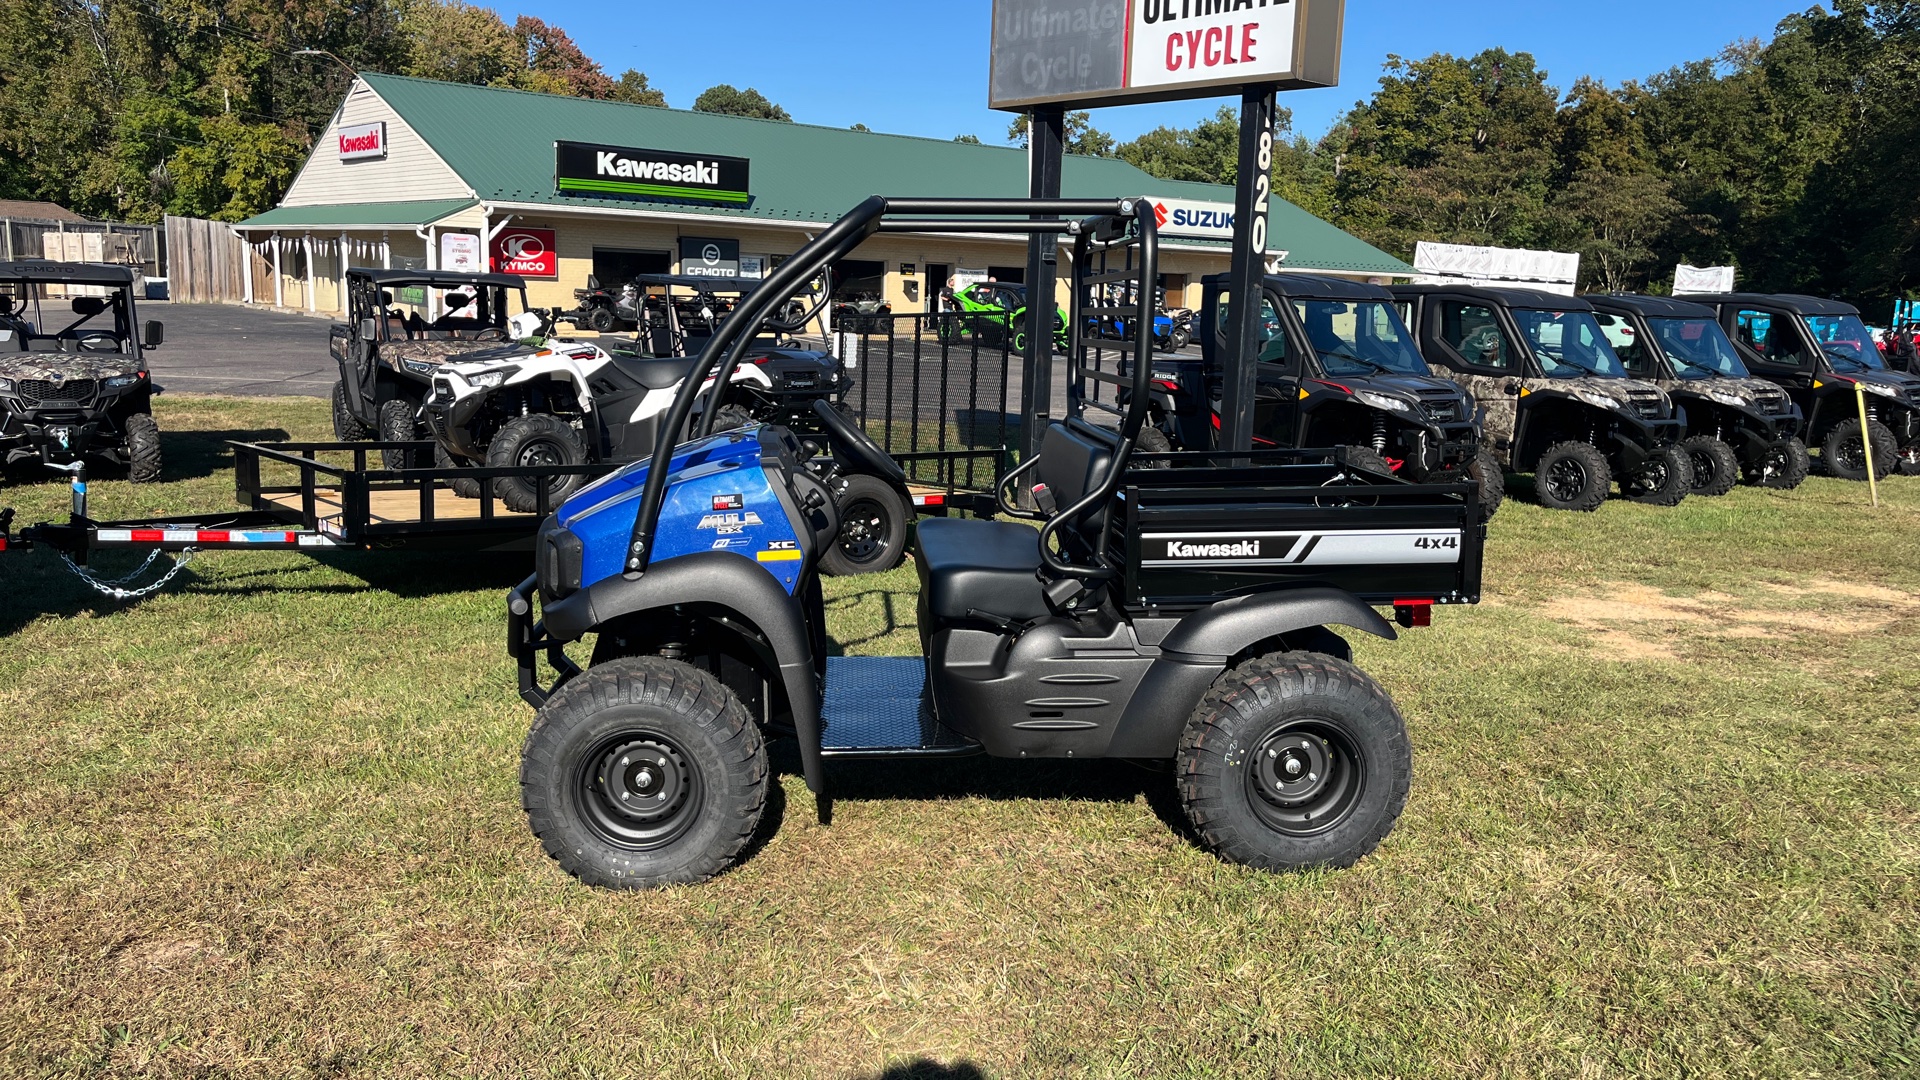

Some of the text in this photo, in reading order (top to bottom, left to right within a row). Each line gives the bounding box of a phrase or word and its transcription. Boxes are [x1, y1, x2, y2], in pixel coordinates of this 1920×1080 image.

[1005, 0, 1116, 41] Ultimate
[1143, 0, 1290, 24] ULTIM
[1166, 22, 1259, 71] CYCLE
[1021, 46, 1092, 90] Cycle
[339, 129, 379, 153] Kawasaki
[596, 151, 719, 185] Kawasaki
[1172, 208, 1235, 229] SUZUK
[14, 266, 75, 274] CFMOTO
[500, 261, 545, 271] KYMCO
[686, 267, 736, 277] CFMOTO
[697, 512, 764, 529] MULE
[768, 541, 796, 549] XC
[1167, 540, 1260, 557] Kawasaki
[1414, 536, 1458, 549] 4x4
